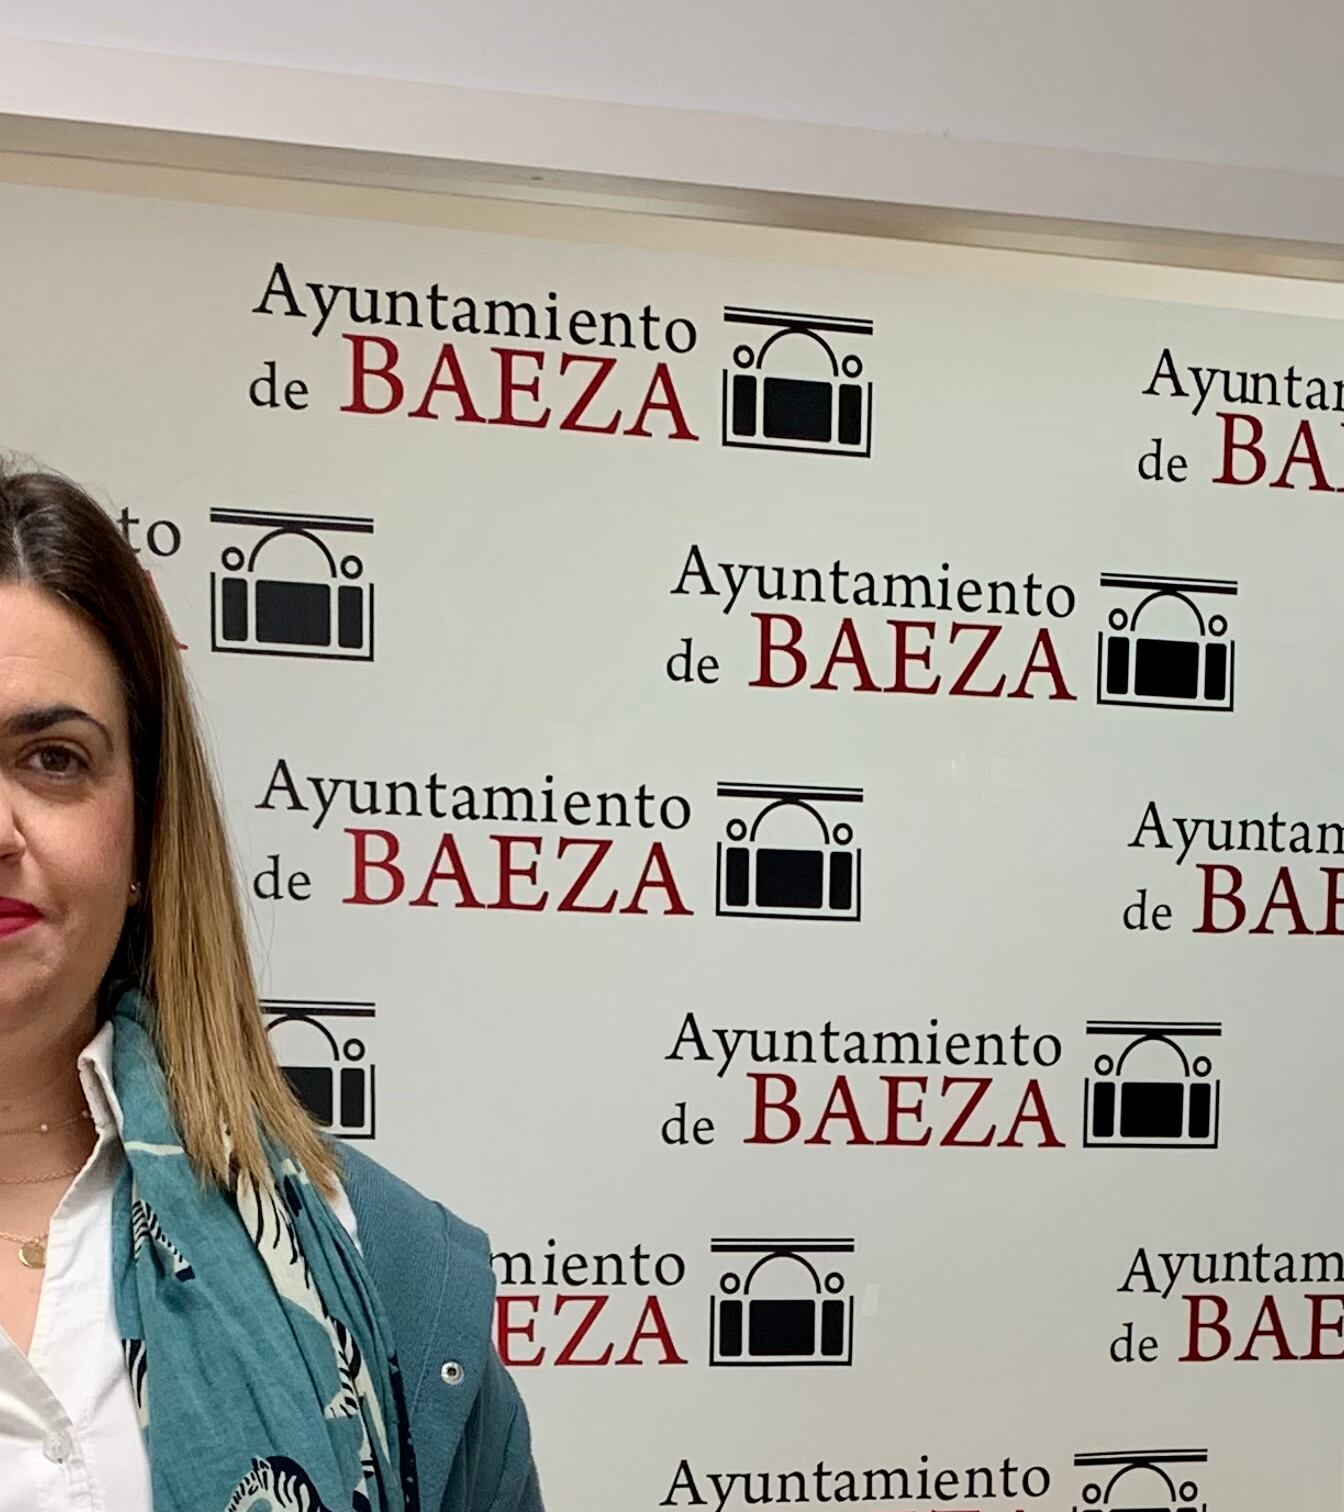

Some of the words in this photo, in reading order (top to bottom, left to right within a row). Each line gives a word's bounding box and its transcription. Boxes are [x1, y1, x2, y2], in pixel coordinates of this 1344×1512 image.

[251, 261, 698, 355] Ayuntamiento
[249, 361, 310, 411] de
[341, 334, 698, 442] BAEZA
[1138, 437, 1188, 483] de
[670, 543, 1077, 619] Ayuntamiento
[666, 636, 720, 685] de
[749, 613, 1077, 700] BAEZA
[255, 758, 692, 834] Ayuntamiento
[252, 856, 311, 902] de
[343, 828, 694, 917] BAEZA
[1123, 889, 1173, 930] de
[664, 1011, 1061, 1080] Ayuntamiento
[661, 1101, 716, 1146] de
[743, 1072, 1065, 1149] BAEZA
[1110, 1322, 1159, 1363] de
